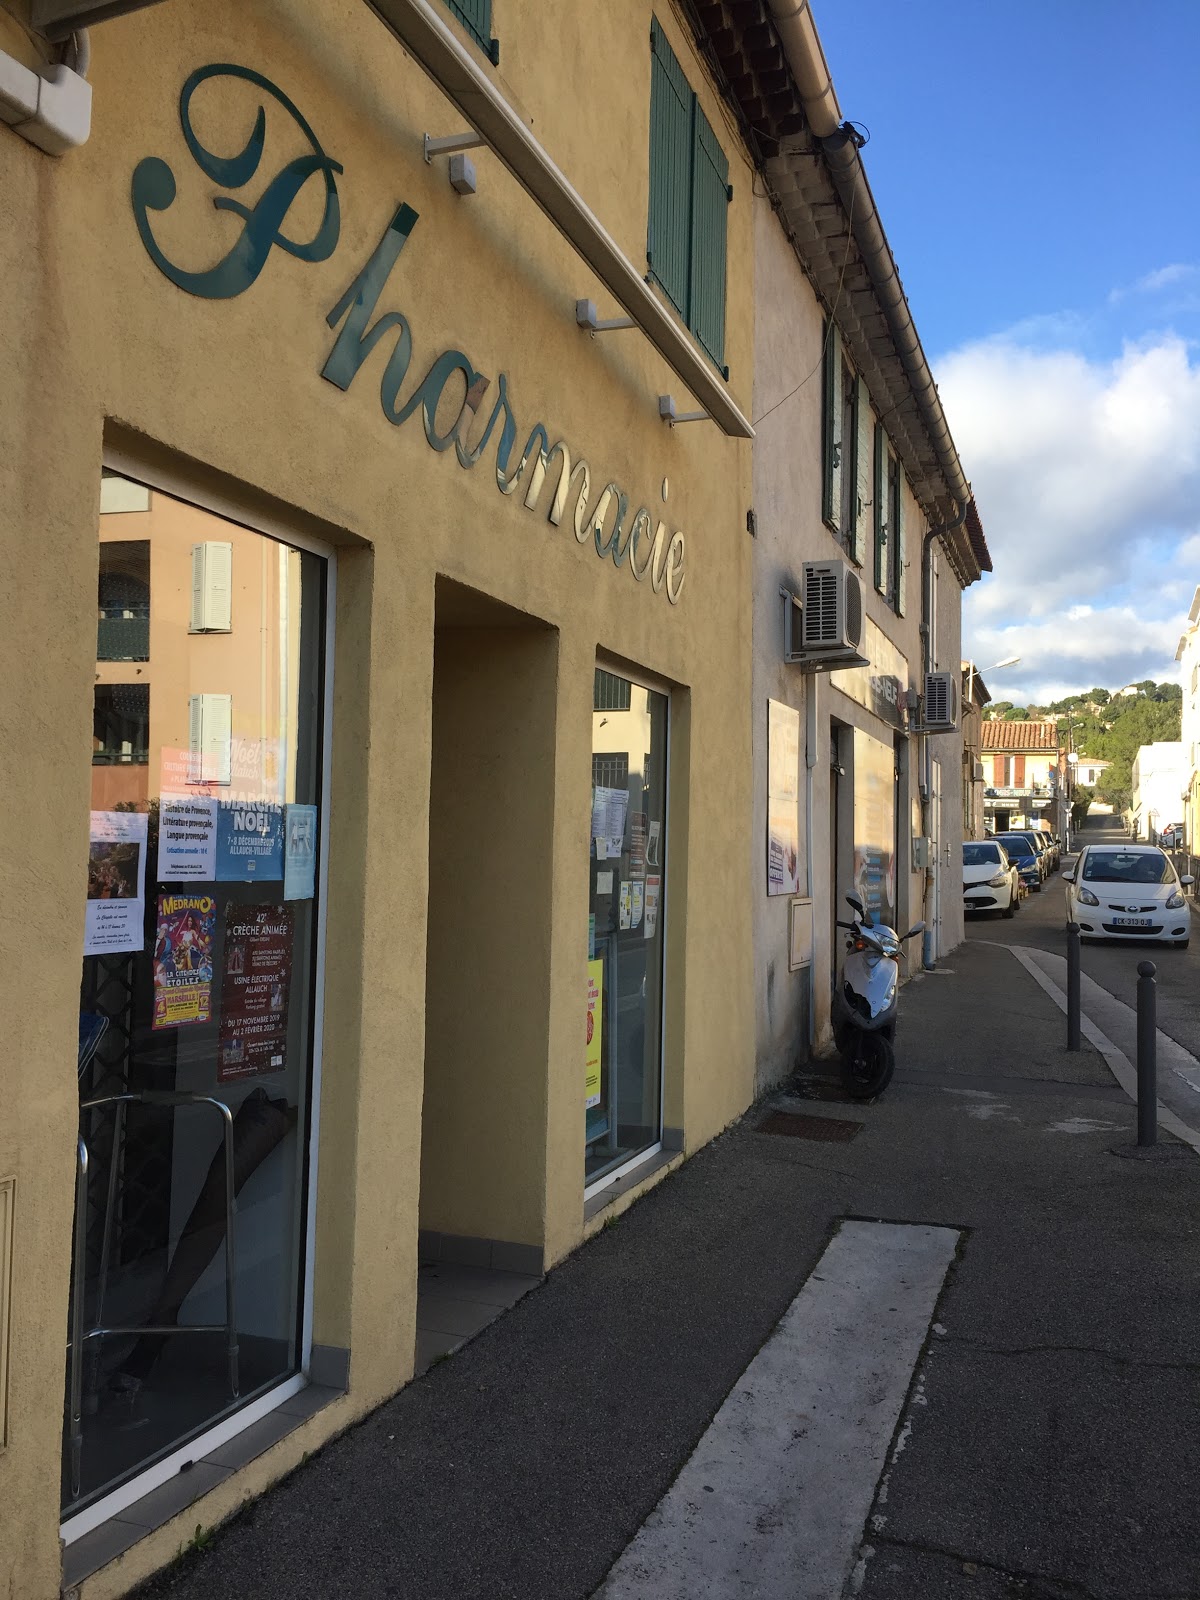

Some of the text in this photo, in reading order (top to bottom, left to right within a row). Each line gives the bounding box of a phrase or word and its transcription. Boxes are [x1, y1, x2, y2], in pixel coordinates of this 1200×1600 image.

[131, 63, 685, 606] Pharmacie
[185, 805, 190, 814] de
[192, 806, 211, 816] Provence,
[163, 817, 213, 830] Littérature provençale,
[167, 831, 208, 842] Langue provençale
[162, 896, 212, 916] MEDRANO
[233, 923, 287, 936] CRÈCHE ANIMÉE
[167, 978, 199, 987] ETOILES
[252, 975, 279, 984] ÉLECTRIQUE
[246, 985, 267, 994] ALLAUCH
[167, 994, 195, 1004] MARSEILLE
[200, 996, 208, 1008] 12
[158, 1002, 165, 1014] 4
[243, 1016, 268, 1025] NOVEMBRE
[245, 1025, 262, 1034] FÉVRIER
[264, 1024, 274, 1032] 2020
